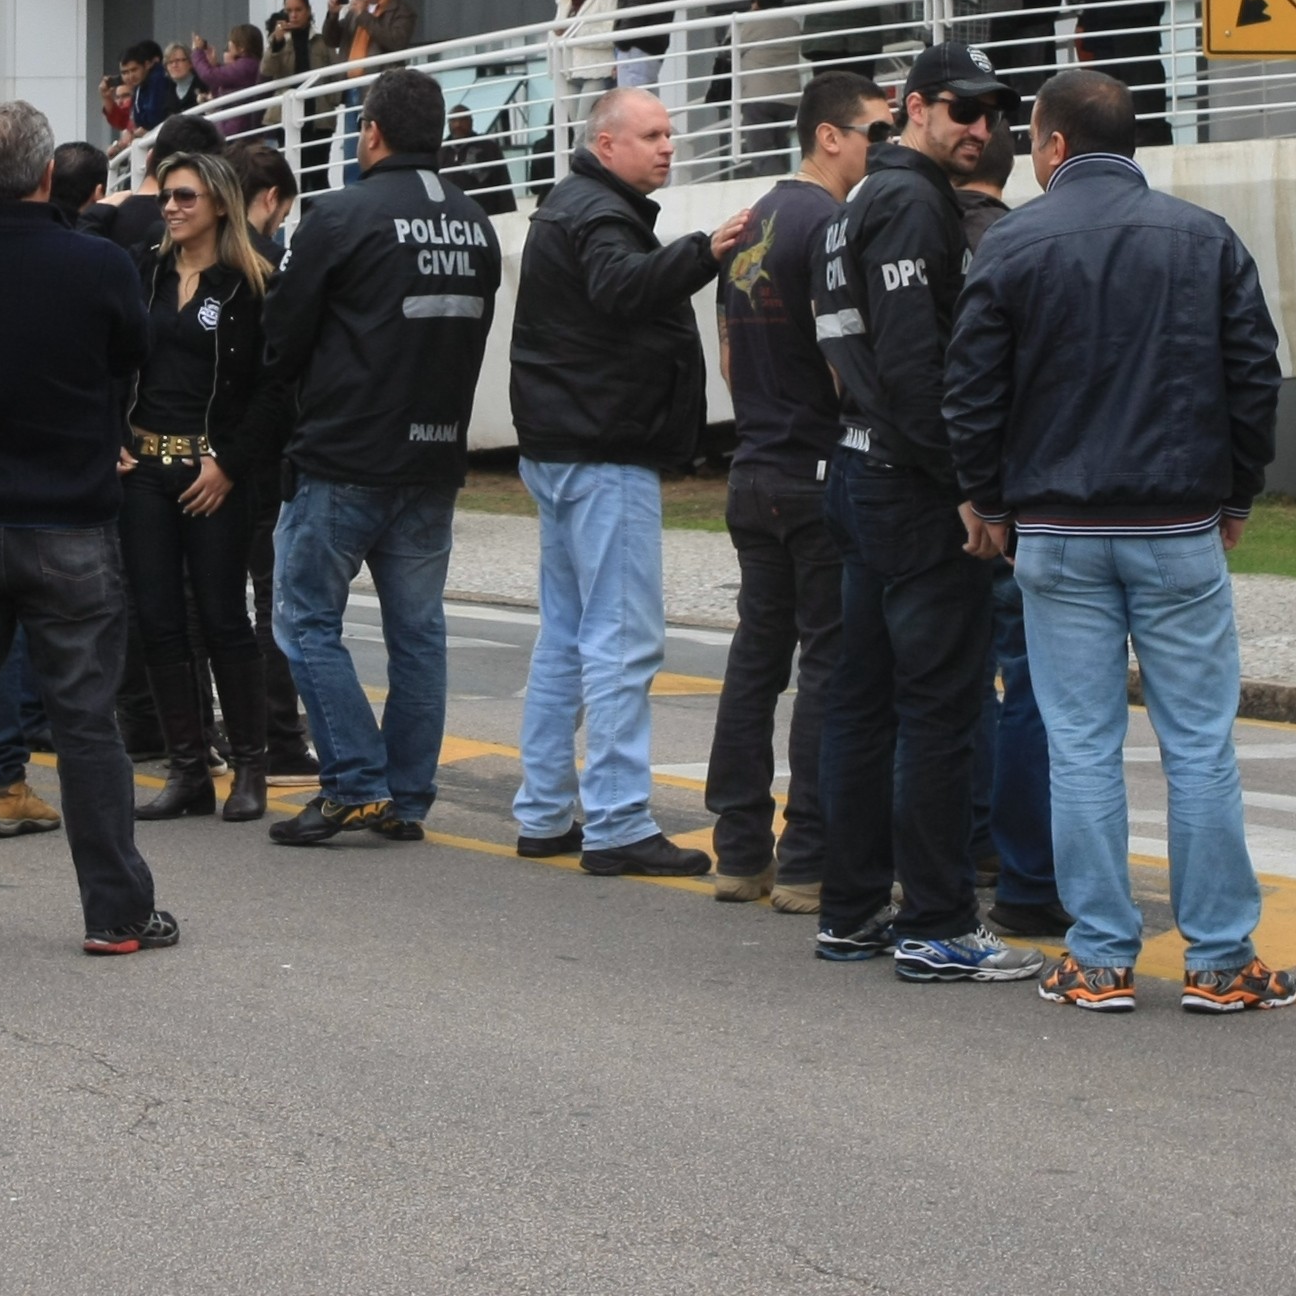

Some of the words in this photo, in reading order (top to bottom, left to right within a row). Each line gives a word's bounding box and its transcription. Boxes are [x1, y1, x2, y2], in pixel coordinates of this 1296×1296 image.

[394, 213, 488, 247] POLÍCIA
[417, 249, 476, 276] CIVIL
[882, 258, 929, 292] DPC
